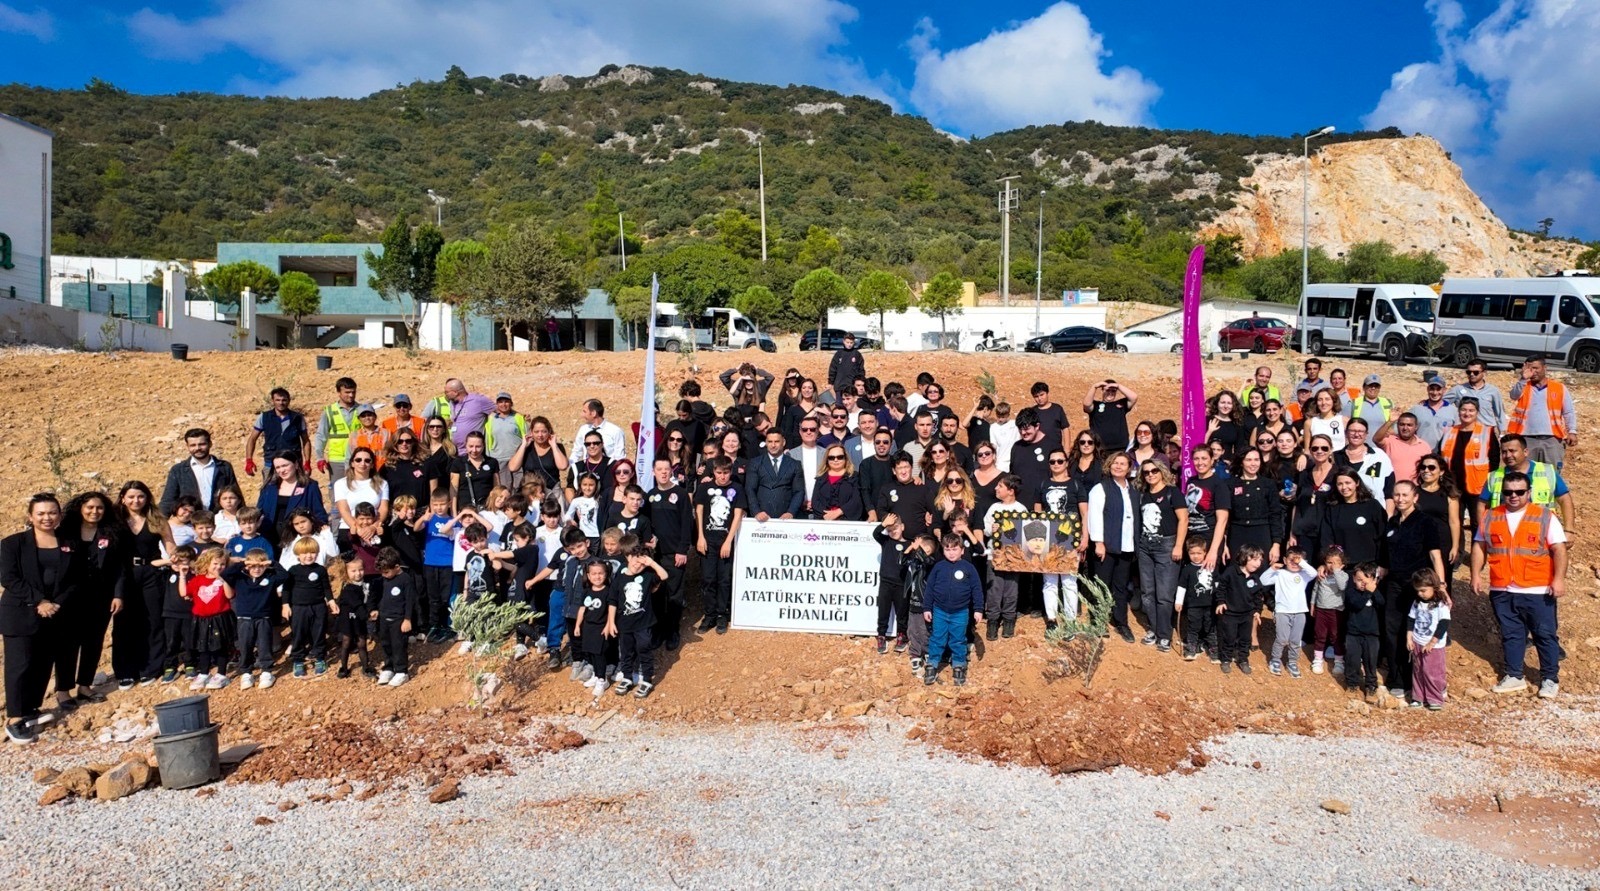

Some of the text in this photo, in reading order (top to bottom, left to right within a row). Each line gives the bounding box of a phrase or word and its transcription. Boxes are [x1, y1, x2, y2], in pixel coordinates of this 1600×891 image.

[821, 534, 859, 542] marmara
[780, 553, 849, 569] BODRUM
[745, 566, 827, 582] MARMARA
[819, 592, 861, 606] NEFES
[779, 606, 848, 622] FİDANLIĞI
